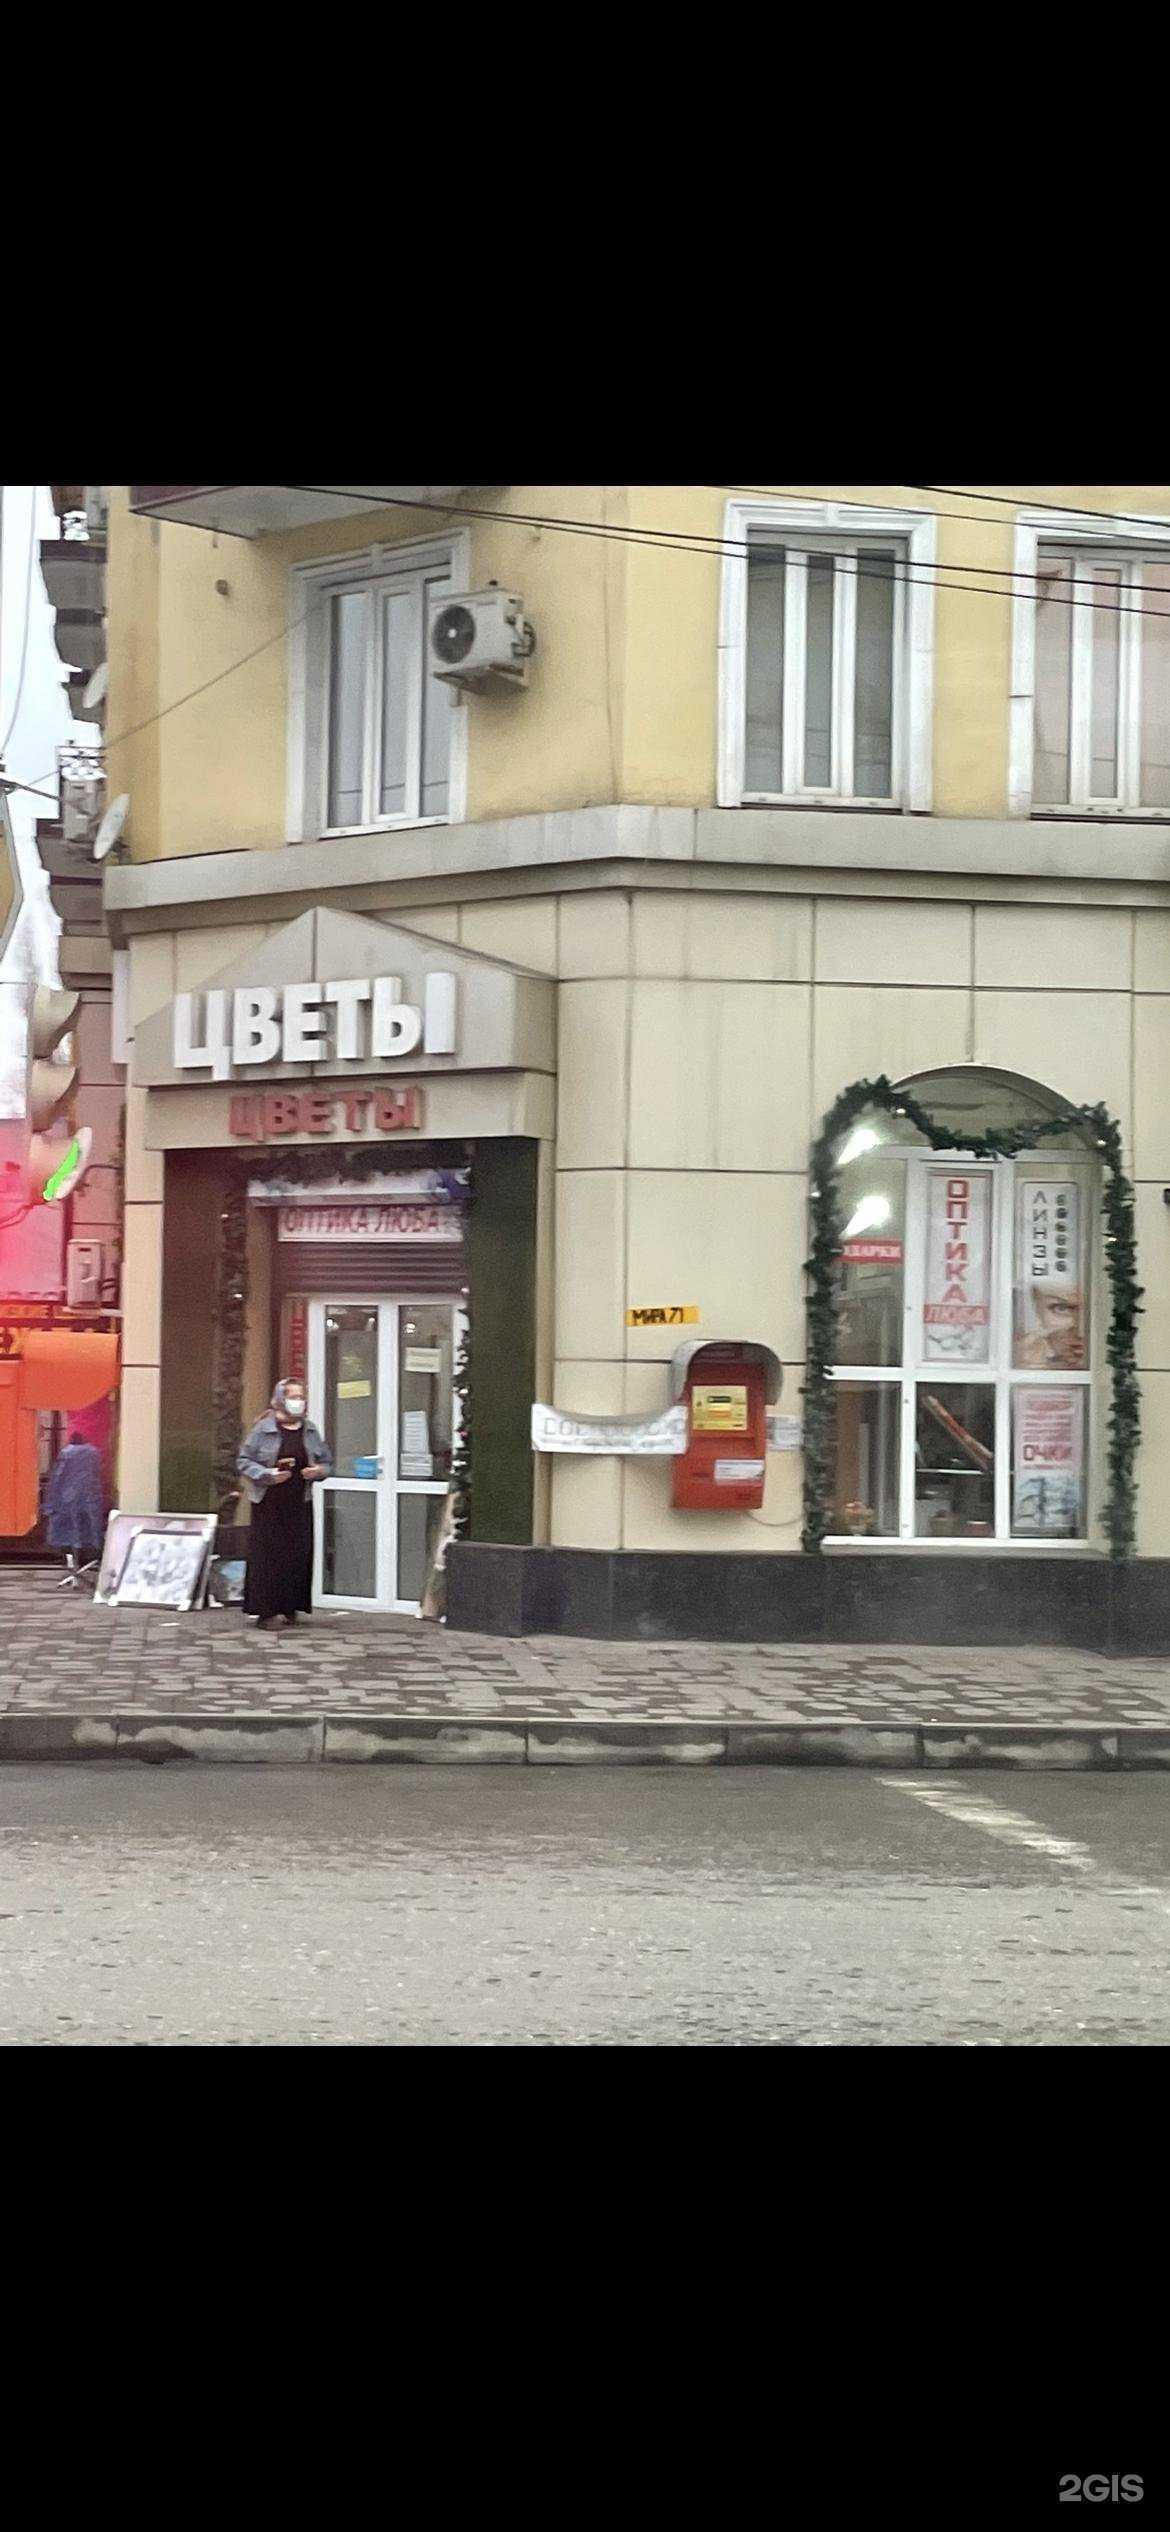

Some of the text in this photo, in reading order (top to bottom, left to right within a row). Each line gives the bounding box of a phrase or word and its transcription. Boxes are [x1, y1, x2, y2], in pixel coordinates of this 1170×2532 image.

[173, 972, 456, 1081] ЦВЕТЫ
[229, 1086, 422, 1142] ЦВЕТЫ
[284, 1206, 440, 1233] ОПТИКА ЛЮБА
[944, 1179, 969, 1302] ОПТИКА
[1032, 1190, 1049, 1277] ЛИНЗЫ
